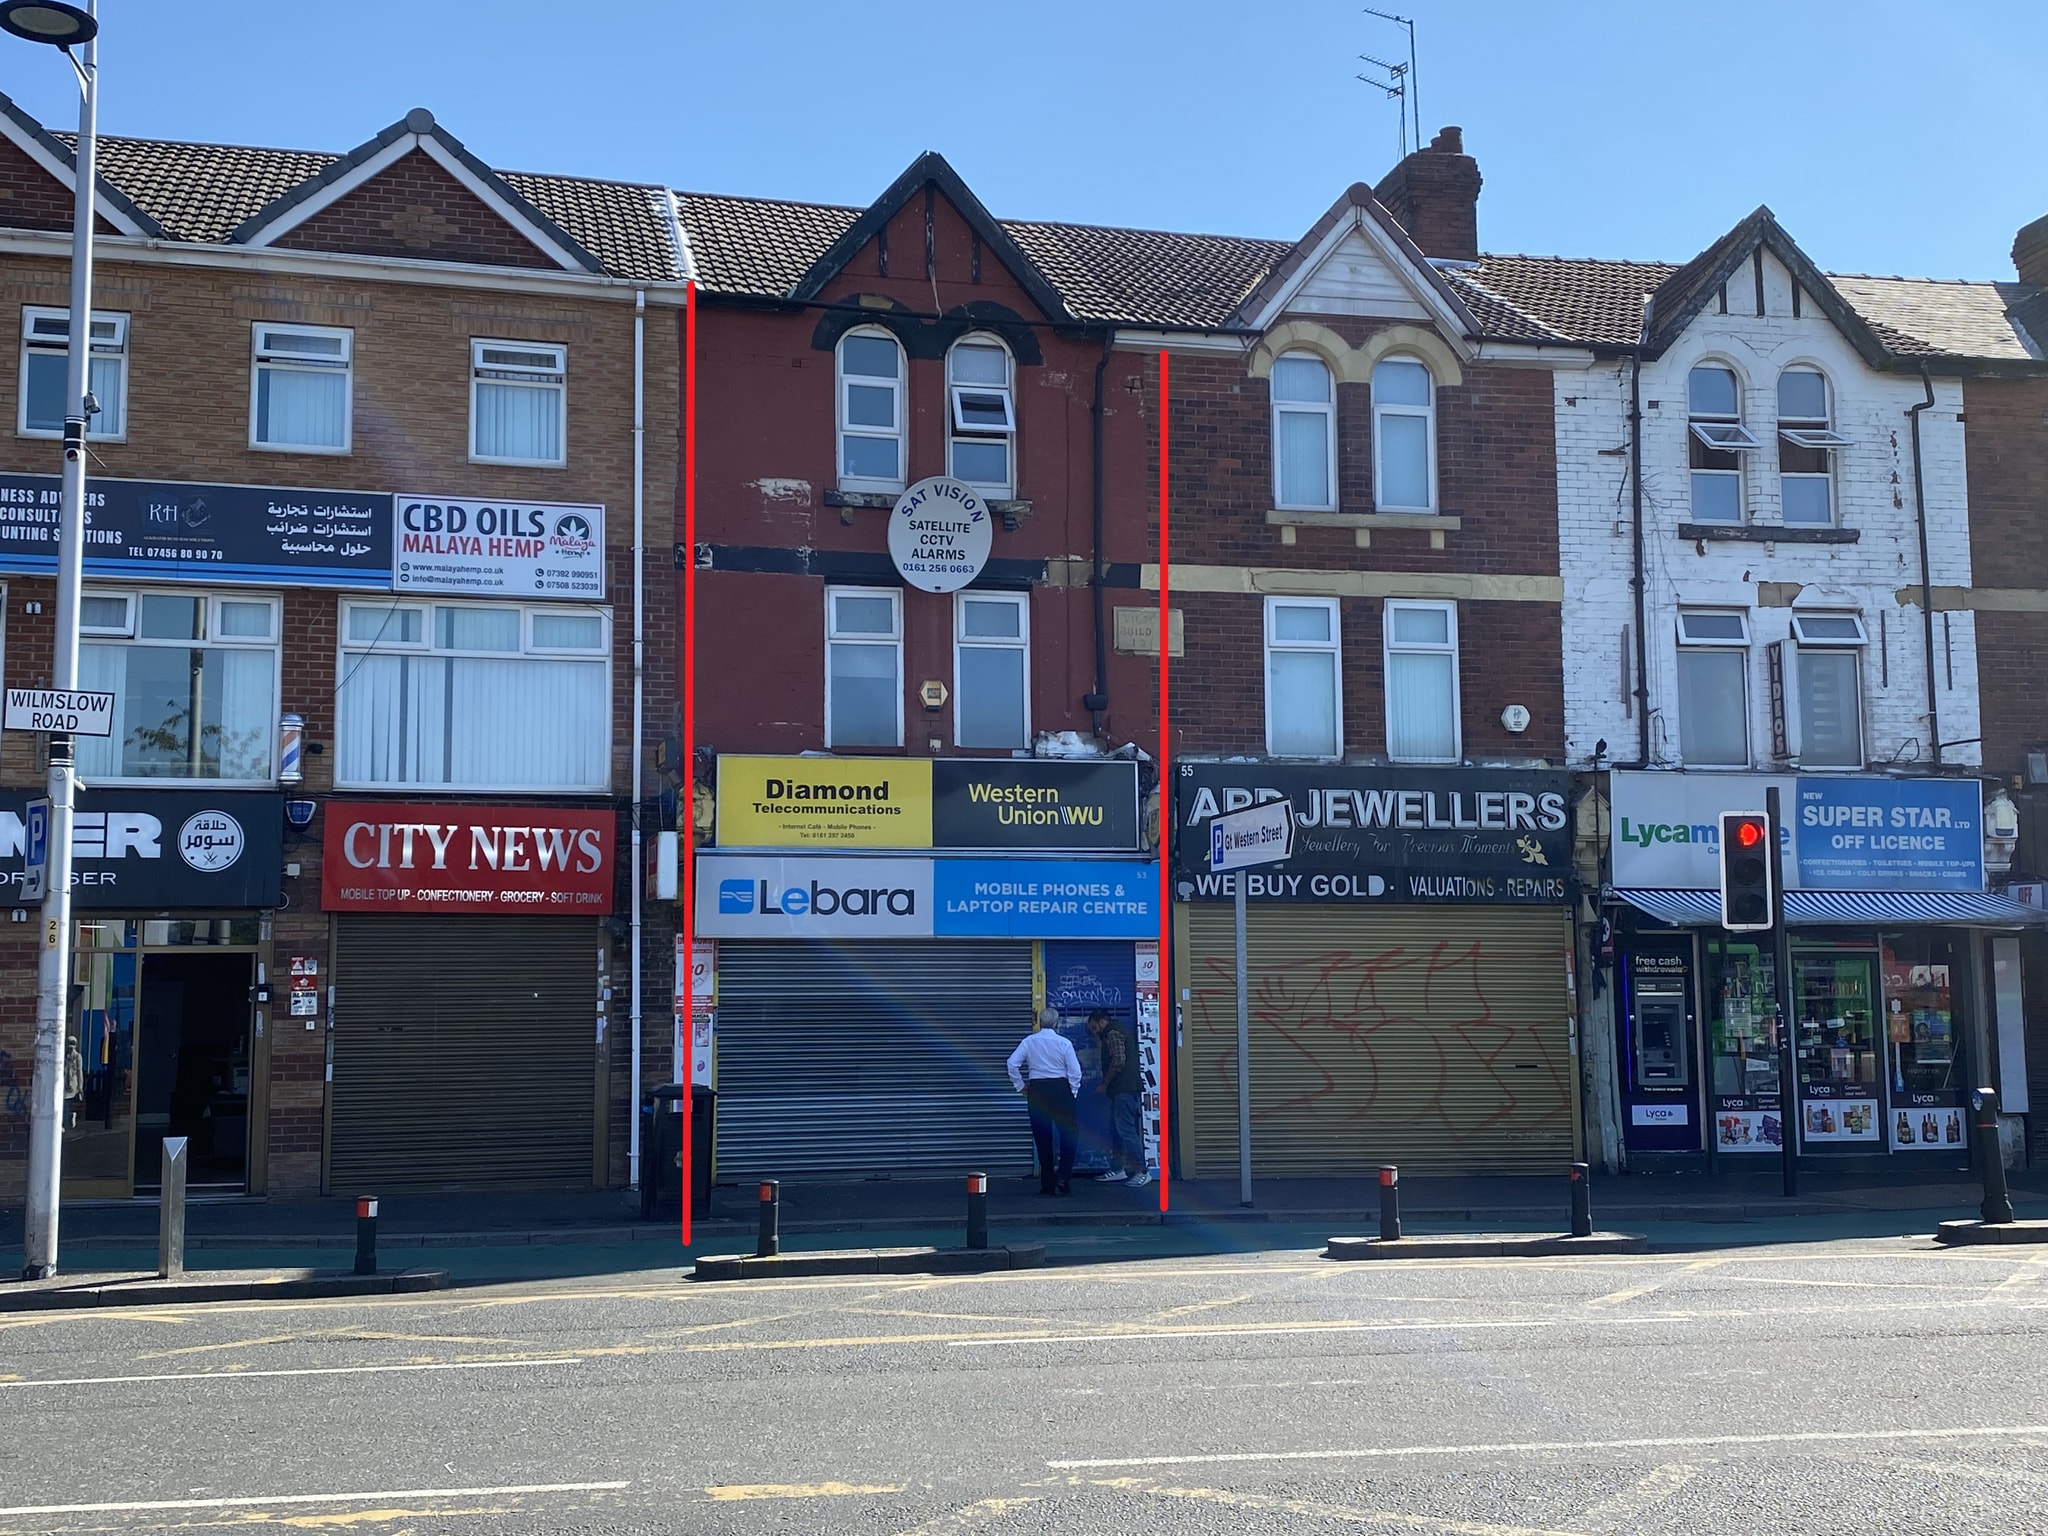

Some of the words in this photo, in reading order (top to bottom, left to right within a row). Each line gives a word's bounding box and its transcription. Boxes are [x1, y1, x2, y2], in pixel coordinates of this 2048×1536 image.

[40, 490, 105, 507] ADERS
[901, 488, 928, 517] SAT
[933, 484, 985, 523] VISION
[0, 507, 92, 524] CONSULTS
[150, 504, 178, 522] KH
[267, 502, 308, 518] تجارية
[313, 504, 372, 520] استشارات
[403, 504, 467, 533] CBD
[476, 507, 545, 537] OILS
[909, 520, 971, 533] SATELLITE
[53, 528, 122, 544] STIONS
[313, 522, 372, 537] استشارات
[281, 539, 335, 554] محاسبية
[402, 534, 483, 556] MALAYA
[489, 537, 545, 558] HEMP
[549, 536, 596, 551] Malaya
[920, 534, 954, 545] CCTV
[128, 547, 144, 557] TEL
[147, 547, 177, 558] 07456
[180, 549, 192, 559] 80
[196, 549, 208, 559] 90
[211, 550, 223, 560] 70
[340, 542, 371, 556] حلول
[911, 548, 966, 560] ALARMS
[412, 564, 504, 575] www.malayahemp.co.uk
[903, 562, 926, 572] 0161
[928, 564, 947, 572] 256
[950, 565, 975, 573] 0663
[412, 575, 504, 586] info@malayahemp.co.uk
[11, 691, 109, 712] WILMSLOW
[1770, 646, 1784, 753] VIDEOS
[31, 712, 79, 730] ROAD
[1181, 765, 1194, 776] 55
[766, 779, 889, 801] Diamond
[968, 783, 1059, 803] Western
[1803, 792, 1823, 800] NEW
[752, 802, 902, 815] Telecommunications
[998, 804, 1059, 825] Union
[1296, 788, 1567, 832] JEWELLERS
[194, 820, 227, 830] حلاقة
[1803, 805, 1884, 827] SUPER
[1890, 807, 1952, 828] STAR
[1954, 821, 1971, 830] LTD
[1225, 834, 1233, 850] Gt
[1234, 830, 1260, 848] Western
[1261, 822, 1283, 843] Street
[1621, 817, 1791, 848] Lycame
[185, 835, 234, 850] سومر
[343, 822, 458, 870] CITY
[468, 826, 602, 873] NEWS
[1301, 832, 1361, 860] Jewellery
[1368, 833, 1391, 852] For
[1400, 833, 1455, 853] Precious
[1459, 834, 1516, 854] Moments
[1831, 834, 1865, 850] OFF
[1870, 835, 1946, 850] LICENCE
[0, 872, 117, 885] RSER
[1195, 874, 1236, 896] WE
[1248, 875, 1303, 896] BUY
[1310, 875, 1385, 897] GOLD
[1409, 876, 1495, 896] VALUATIONS
[1507, 878, 1565, 898] REPAIRS
[340, 888, 375, 900] MOBILE
[376, 888, 396, 900] TOP
[397, 889, 411, 901] UP
[416, 889, 495, 902] CONFECTIONERY
[500, 890, 545, 903] GROCERY
[550, 892, 574, 903] SOFT
[575, 892, 603, 904] DRINK
[760, 879, 915, 916] Lebara
[975, 882, 1038, 896] MOBILE
[1043, 884, 1110, 896] PHONES
[1114, 884, 1125, 897] &
[947, 900, 1014, 913] LAPTOP
[1018, 901, 1078, 914] REPAIR
[1082, 902, 1148, 915] CENTRE
[1635, 955, 1656, 966] free
[1658, 956, 1682, 966] cash
[1809, 1085, 1830, 1095] Lyca
[1722, 1098, 1744, 1108] Lyca
[1912, 1093, 1934, 1104] Lyca
[1645, 1109, 1667, 1119] Lyca
